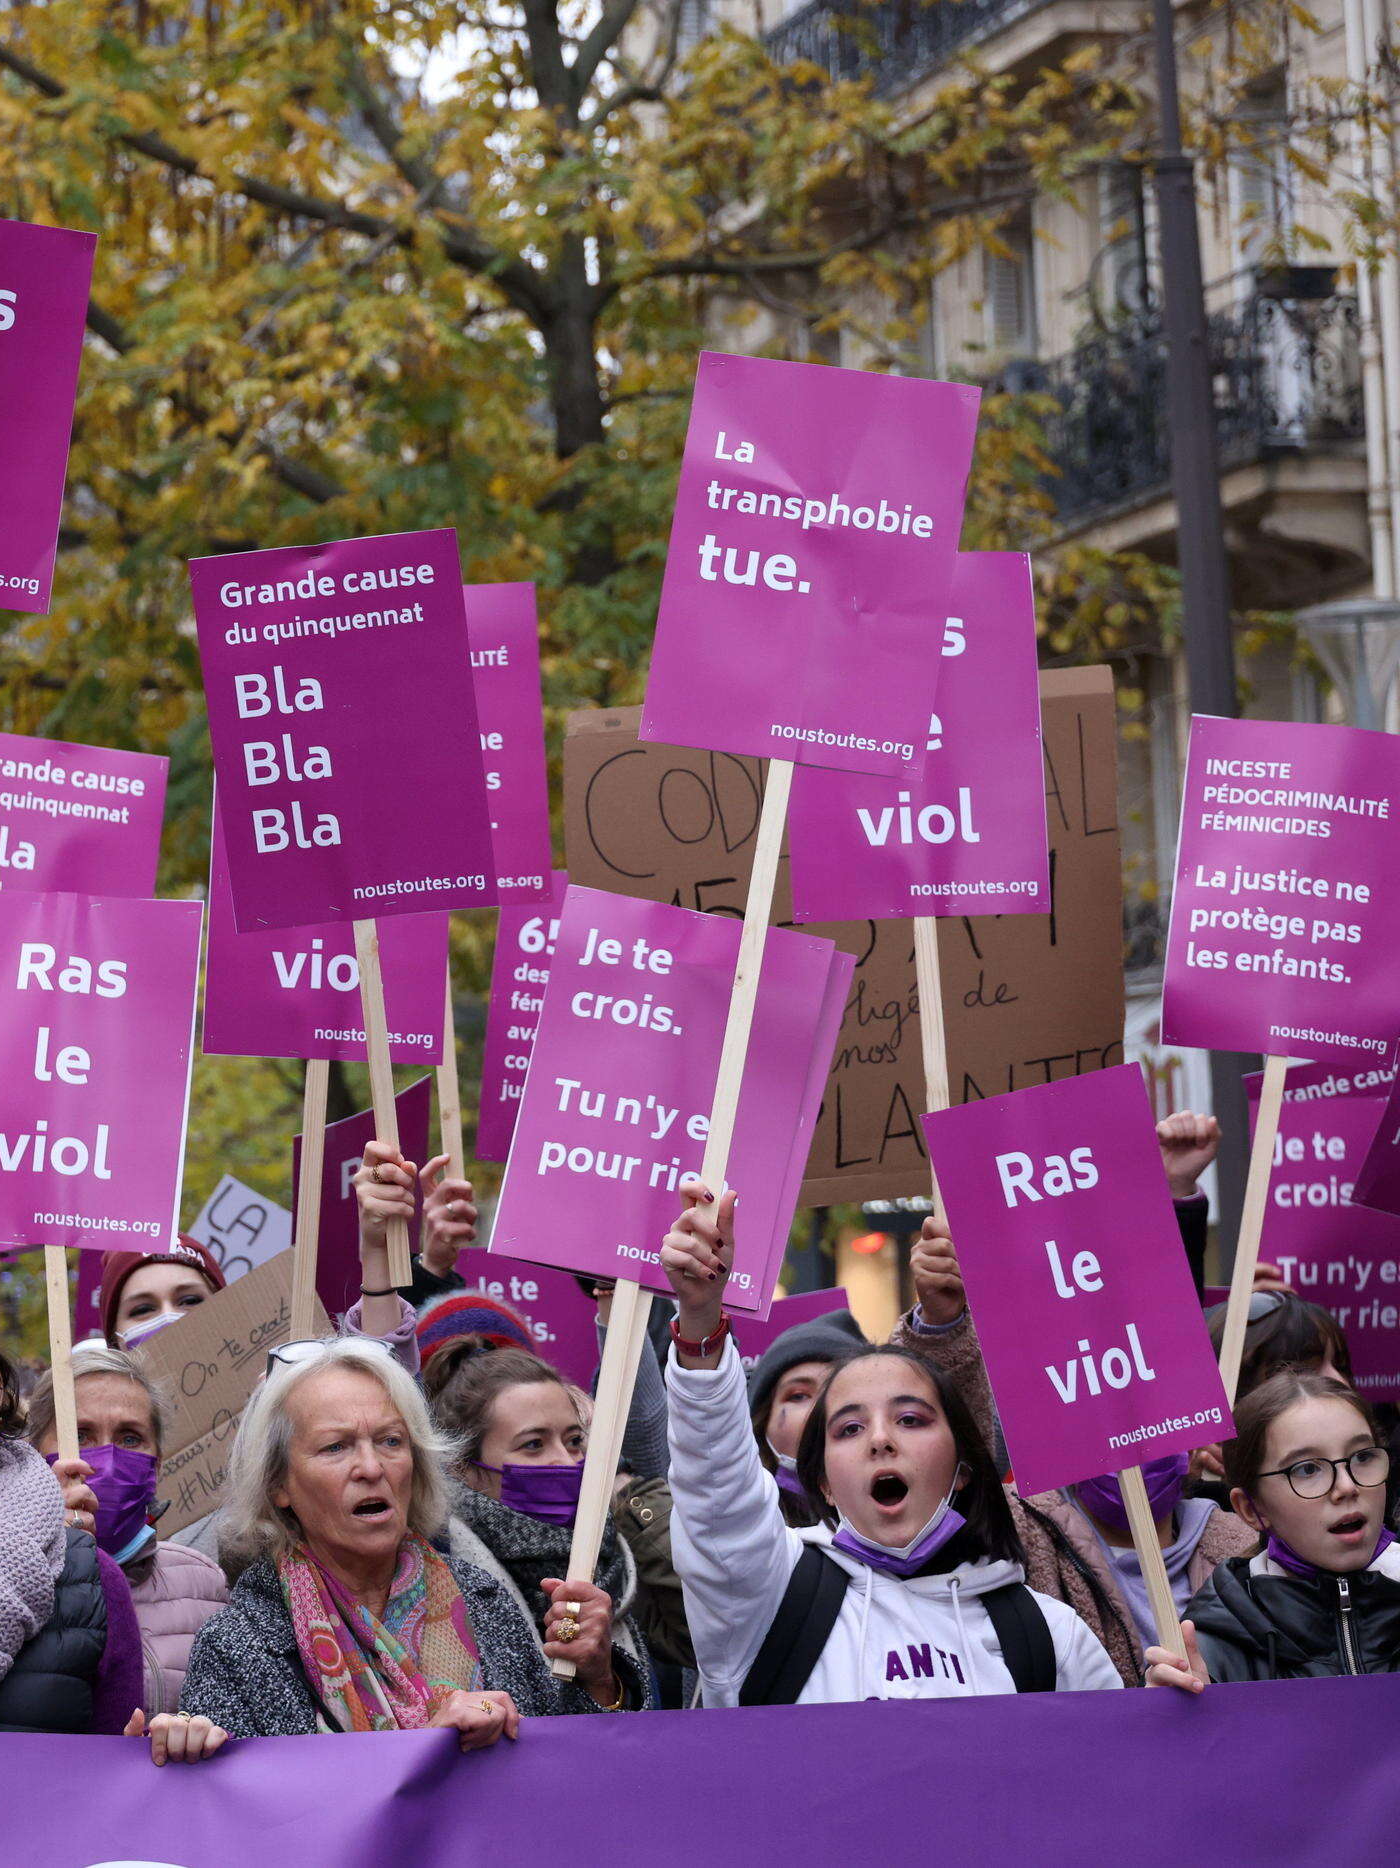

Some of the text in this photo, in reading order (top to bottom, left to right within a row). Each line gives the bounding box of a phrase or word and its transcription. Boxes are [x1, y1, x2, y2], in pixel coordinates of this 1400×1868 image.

[714, 431, 756, 464] La
[706, 480, 934, 538] transphobie
[220, 562, 435, 608] Grande cause
[699, 535, 811, 594] tue.
[224, 602, 424, 646] du quinquennat
[234, 665, 324, 719] Bla
[243, 733, 333, 787] Bla
[770, 722, 914, 761] noustoutes.org
[70, 769, 146, 797] cause
[1205, 758, 1292, 780] INCESTE
[856, 787, 981, 847] viol
[1203, 783, 1390, 820] PÉDOCRIMINALITÉ
[252, 801, 342, 854] Bla
[1200, 810, 1332, 838] FÉMINICIDES
[353, 873, 486, 901] noustoutes.org
[910, 878, 1038, 898] noustoutes.org
[1195, 865, 1370, 904] La justice ne
[1190, 906, 1362, 944] protège pas
[16, 943, 128, 998] Ras
[272, 938, 361, 992] vio
[579, 928, 673, 975] Je te
[1186, 942, 1352, 984] les enfants.
[514, 962, 550, 984] des
[963, 970, 1019, 1007] de
[571, 989, 683, 1036] crois.
[33, 1027, 91, 1085] le
[832, 1042, 898, 1073] nos
[1270, 1024, 1388, 1055] noustoutes.org
[554, 1078, 604, 1119] Tu
[614, 1094, 679, 1141] n'y
[687, 1113, 711, 1141] e
[1284, 1075, 1351, 1103] rande
[537, 1140, 641, 1182] pour
[1273, 1132, 1346, 1167] Je te
[994, 1146, 1099, 1209] Ras
[33, 1210, 162, 1238] noustoutes.org
[509, 1276, 539, 1301] te
[1044, 1239, 1105, 1300] le
[1276, 1256, 1318, 1285] Tu
[1327, 1255, 1373, 1292] n'y
[1358, 1299, 1400, 1329] rie
[181, 1361, 218, 1397] On
[217, 1338, 245, 1360] te
[1044, 1323, 1156, 1405] viol
[1109, 1405, 1223, 1449] noustoutes.org
[885, 1643, 966, 1685] ANTI
